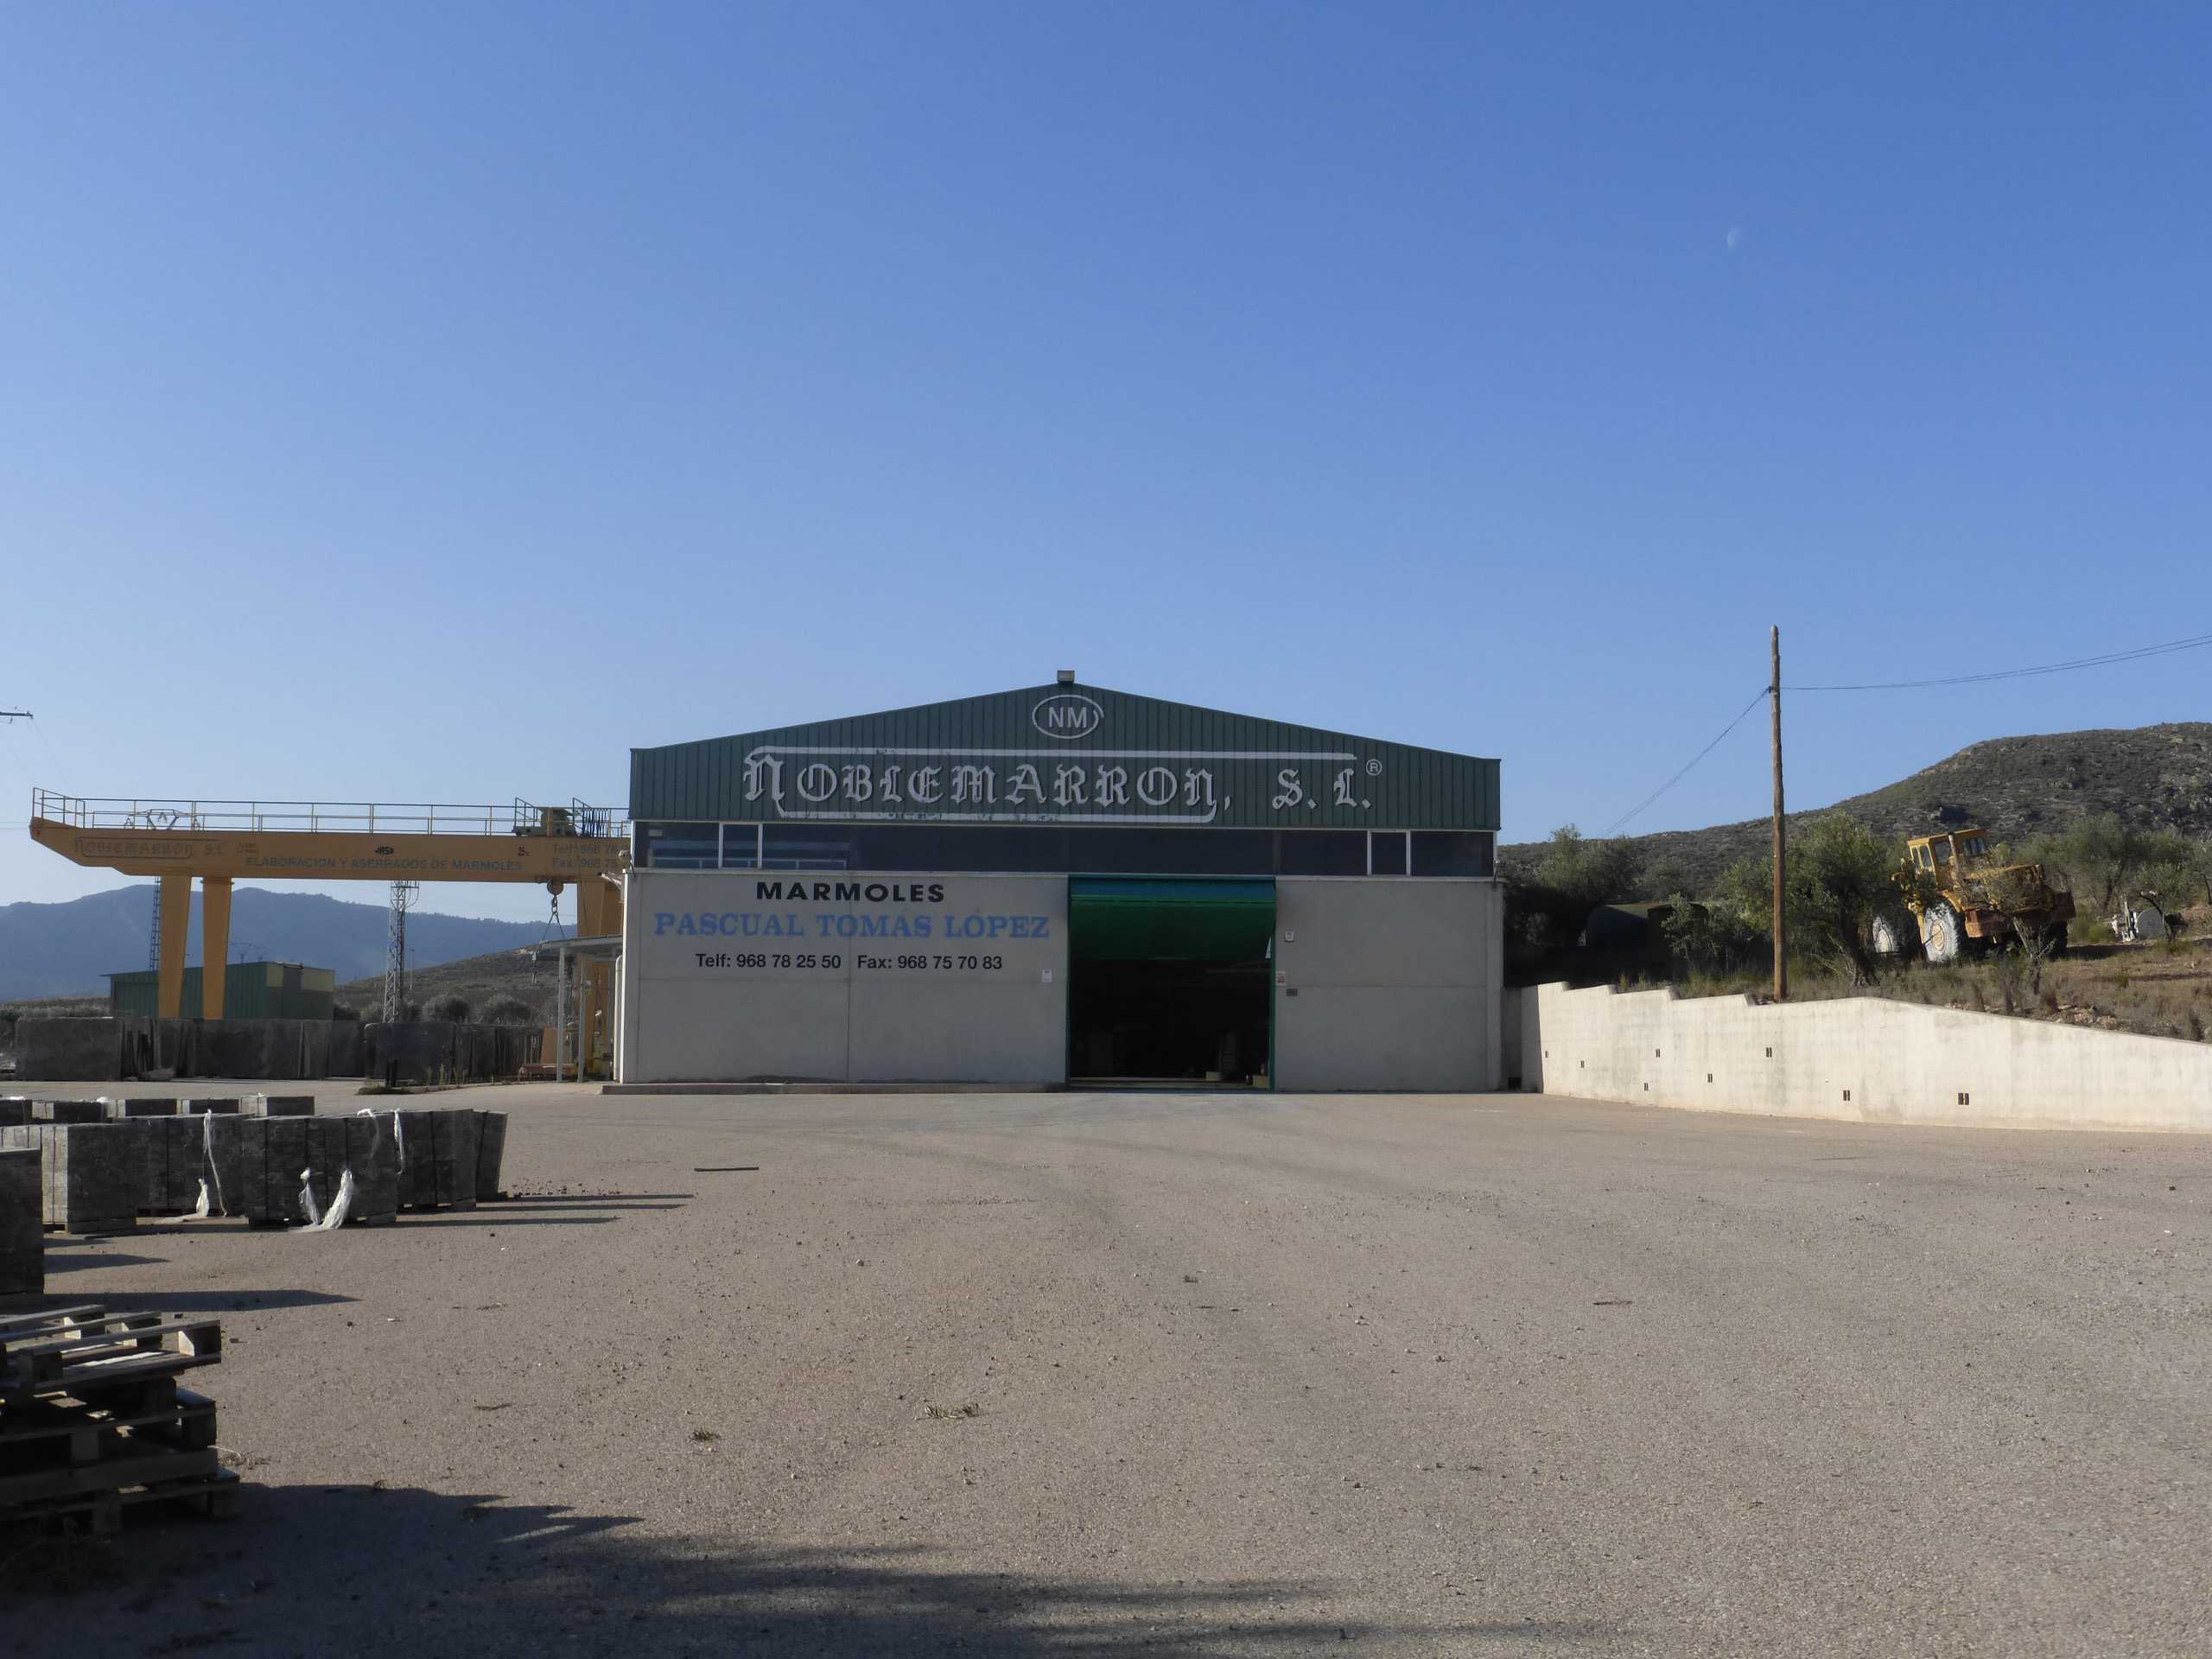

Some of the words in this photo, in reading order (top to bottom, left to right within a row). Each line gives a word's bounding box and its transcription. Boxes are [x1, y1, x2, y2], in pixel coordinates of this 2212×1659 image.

[1047, 707, 1088, 728] NM
[1271, 768, 1317, 810] S.
[430, 859, 448, 871] DE
[756, 881, 944, 902] MARMOLES
[654, 912, 804, 938] PASCUAL
[696, 953, 732, 969] Telf:
[737, 954, 766, 969] 968
[772, 954, 791, 969] 78
[797, 954, 817, 969] 25
[822, 955, 842, 969] 50
[857, 955, 893, 969] Fax:
[898, 955, 927, 969] 968
[933, 955, 952, 969] 75
[957, 956, 977, 969] 70
[982, 956, 1002, 970] 83
